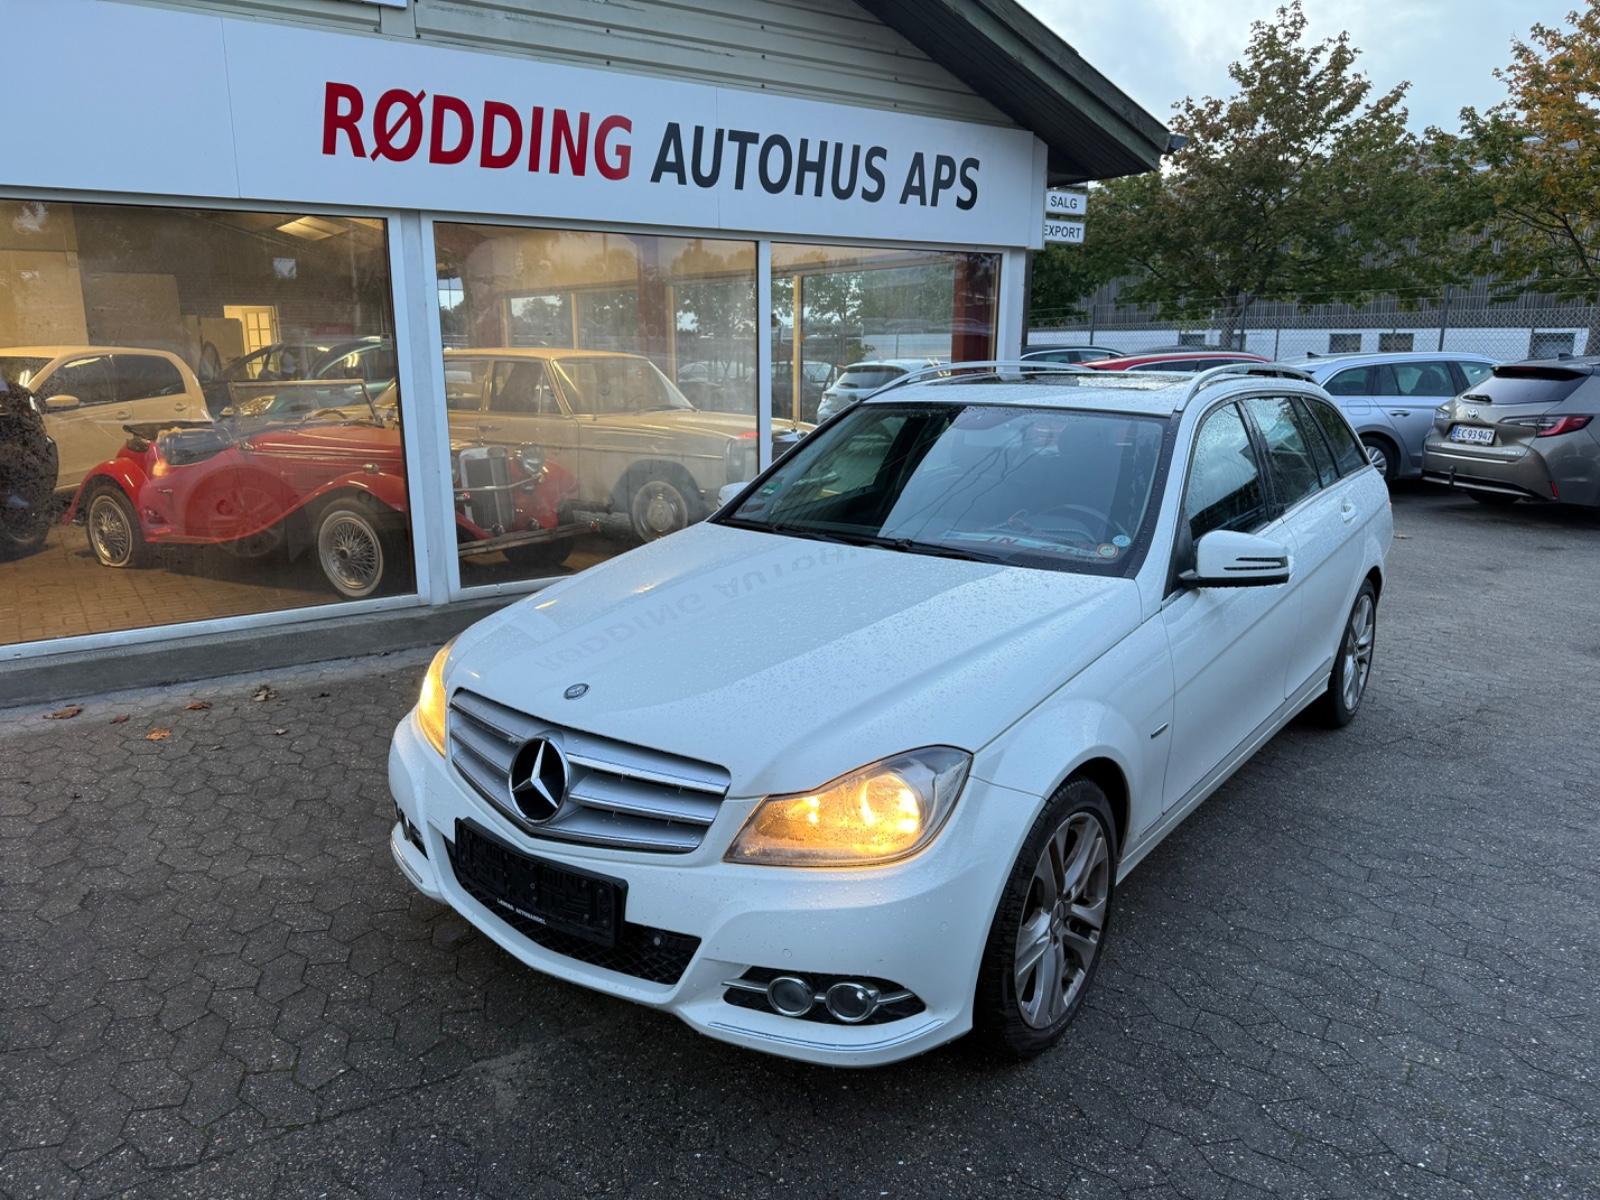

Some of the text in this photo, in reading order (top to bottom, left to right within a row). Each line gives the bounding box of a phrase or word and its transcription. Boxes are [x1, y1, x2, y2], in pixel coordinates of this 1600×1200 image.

[322, 81, 980, 211] RØDDING AUTOHUS APS
[1050, 195, 1078, 209] SALG
[1044, 224, 1082, 239] EXPORT
